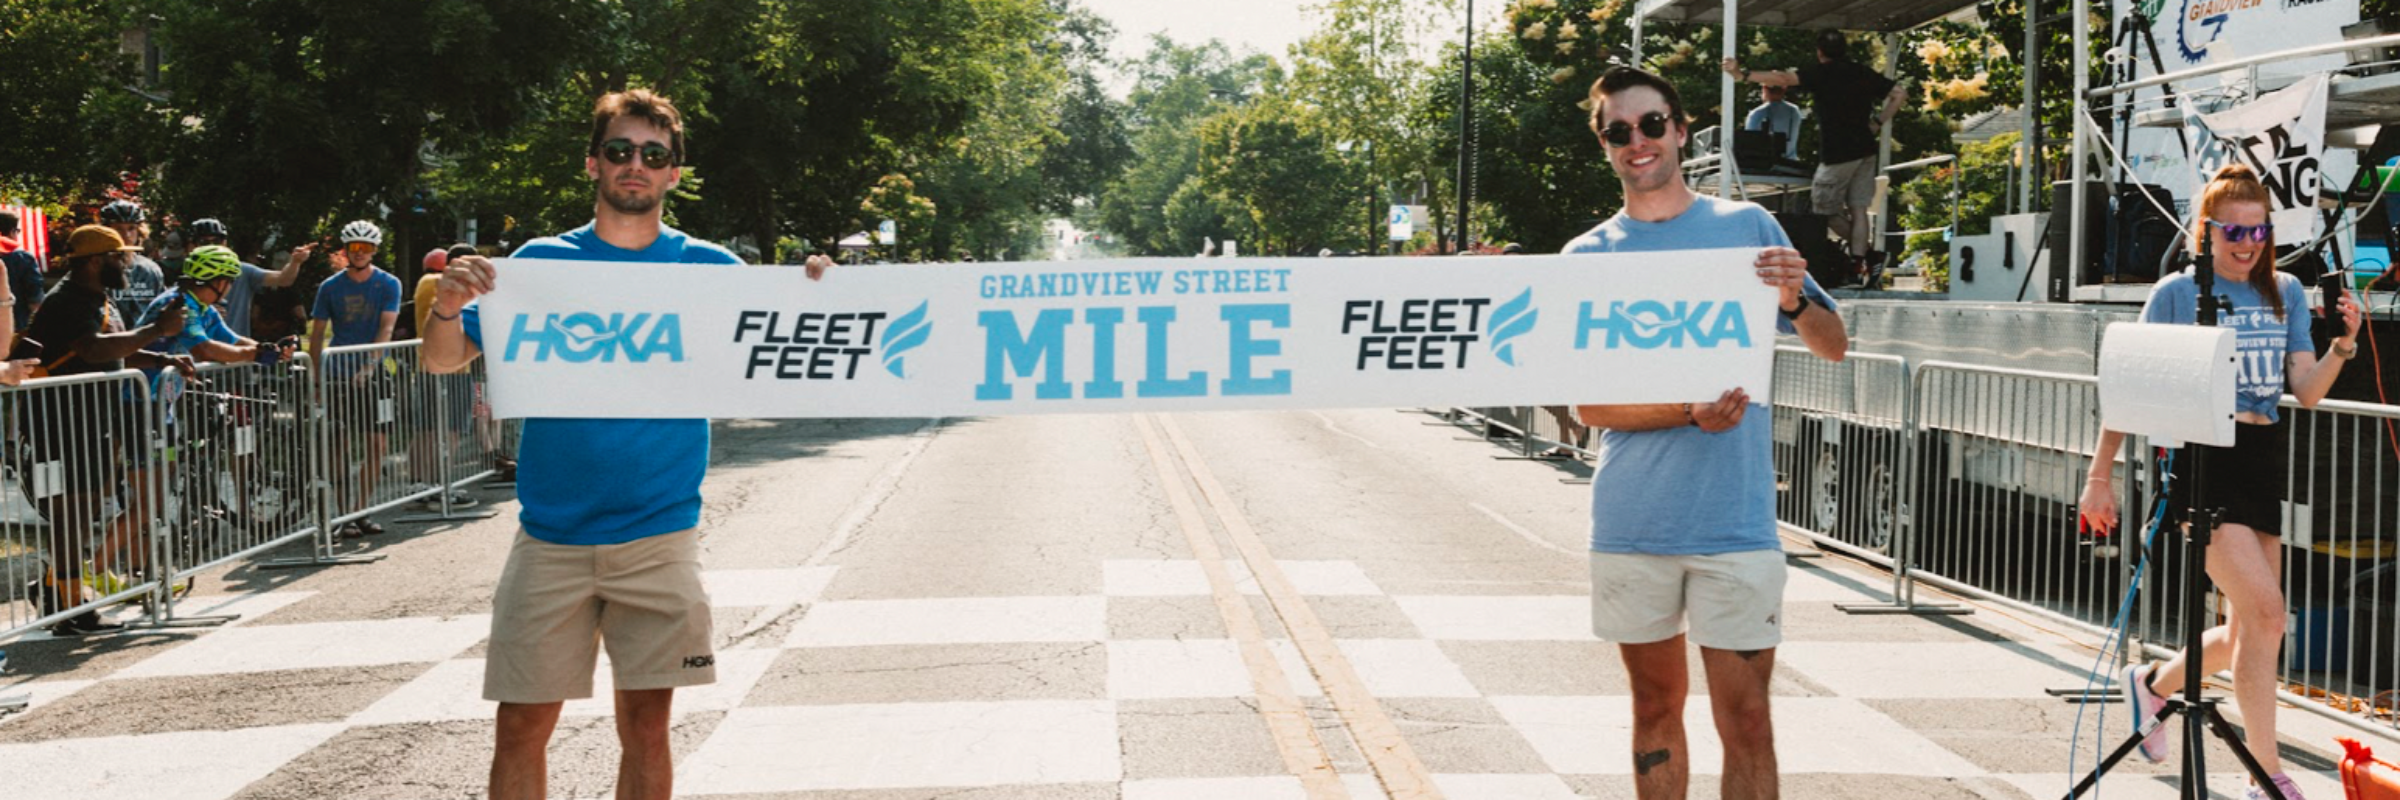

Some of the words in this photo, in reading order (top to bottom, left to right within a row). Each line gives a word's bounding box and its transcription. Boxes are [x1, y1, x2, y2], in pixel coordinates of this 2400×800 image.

[1960, 246, 1974, 283] 2
[980, 270, 1163, 299] GRANDVIEW
[1173, 268, 1292, 295] STREET
[733, 310, 887, 345] FLEET
[1341, 298, 1491, 334] FLEET
[1573, 299, 1753, 350] HOKA
[2217, 314, 2247, 326] LEET
[502, 311, 685, 363] HOKA
[975, 303, 1292, 401] MILE
[1357, 335, 1479, 370] FEET
[745, 345, 872, 380] FEET
